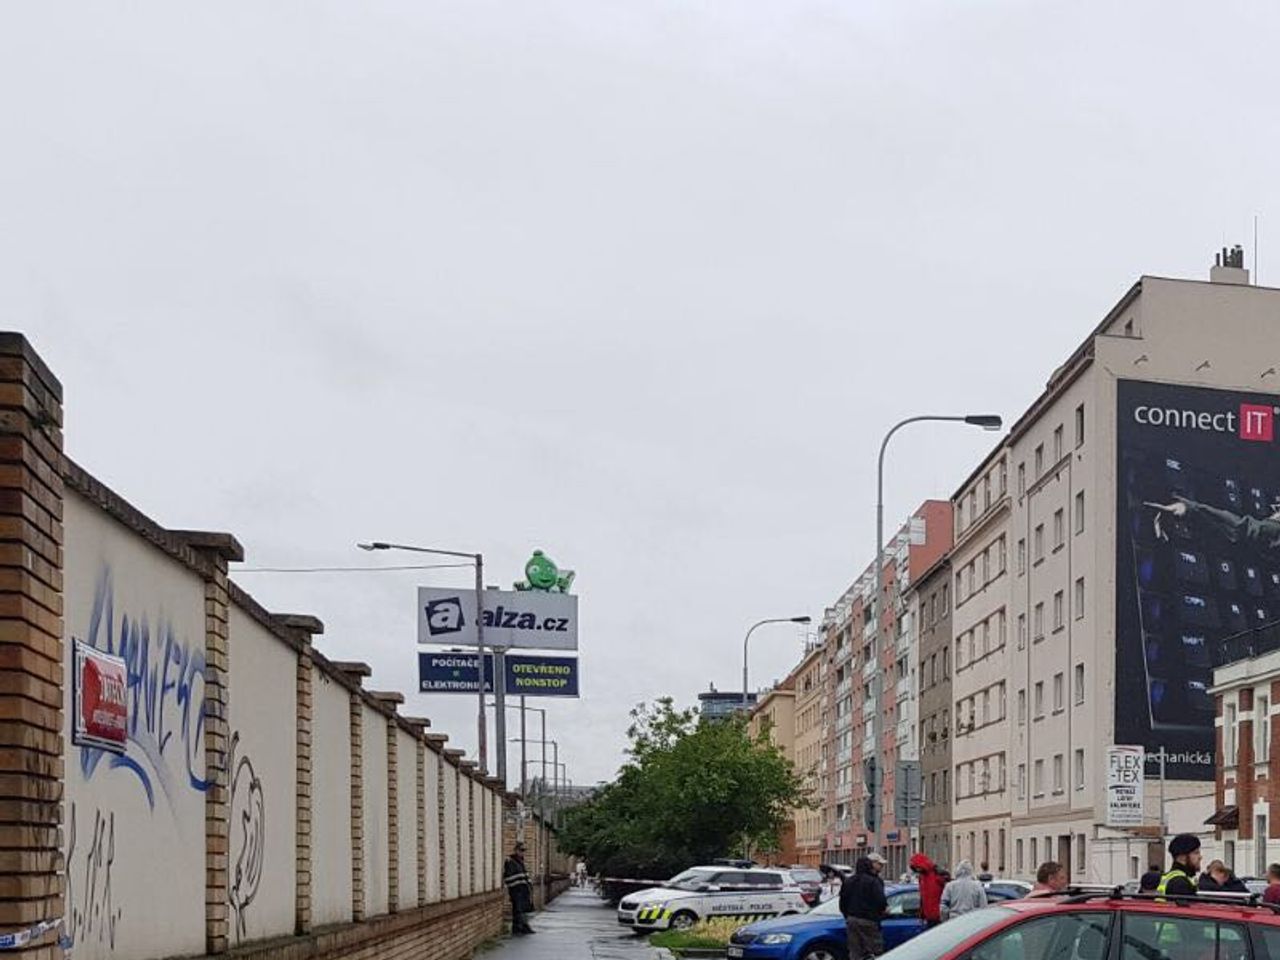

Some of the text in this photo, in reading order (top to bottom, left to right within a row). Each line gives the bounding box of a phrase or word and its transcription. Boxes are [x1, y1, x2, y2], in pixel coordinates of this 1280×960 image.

[1135, 406, 1268, 434] connect IT
[476, 606, 569, 631] alza.cz
[422, 680, 491, 690] ELEKTRONIA
[515, 678, 568, 688] NONSTOP
[1110, 755, 1141, 769] FLEX
[1111, 770, 1139, 783] -TEX
